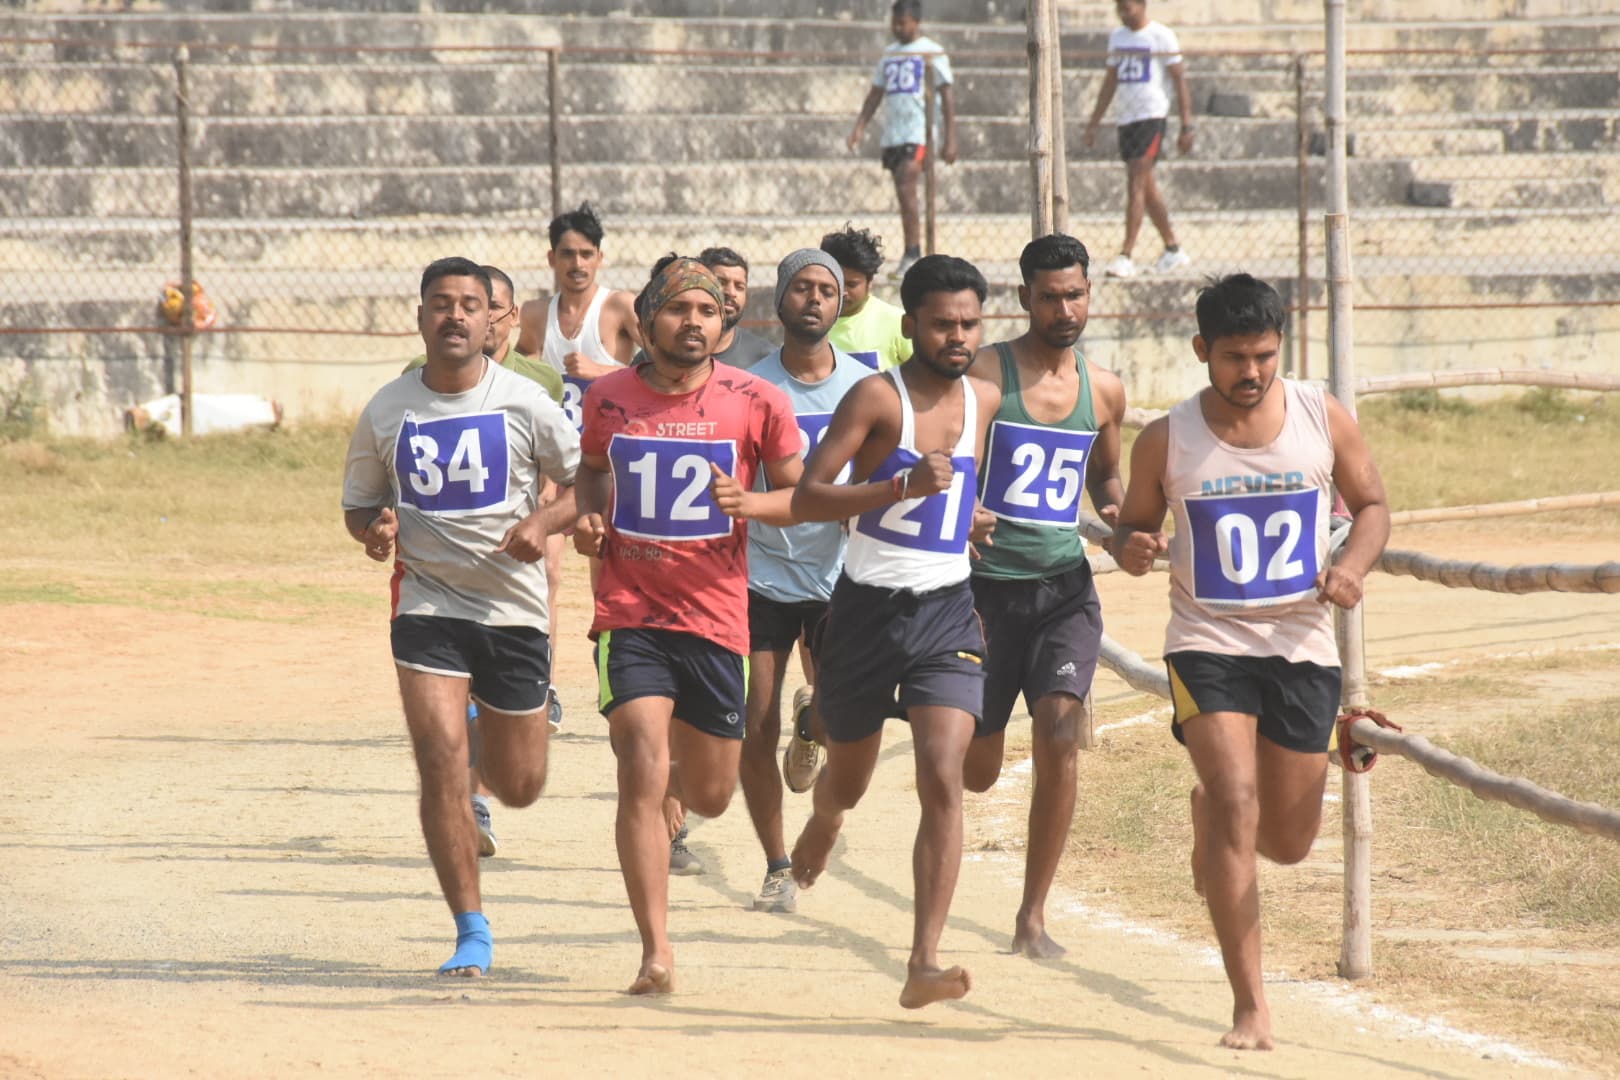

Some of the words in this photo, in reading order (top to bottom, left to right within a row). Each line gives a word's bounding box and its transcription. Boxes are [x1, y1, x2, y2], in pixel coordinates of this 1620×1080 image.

[885, 61, 915, 90] 26
[1116, 55, 1144, 80] 25
[408, 427, 489, 496] 34
[655, 421, 718, 437] STREET
[628, 451, 712, 521] 12
[879, 467, 965, 541] 21
[1002, 442, 1084, 511] 25
[1201, 471, 1305, 496] NEVER
[1215, 509, 1304, 585] 02
